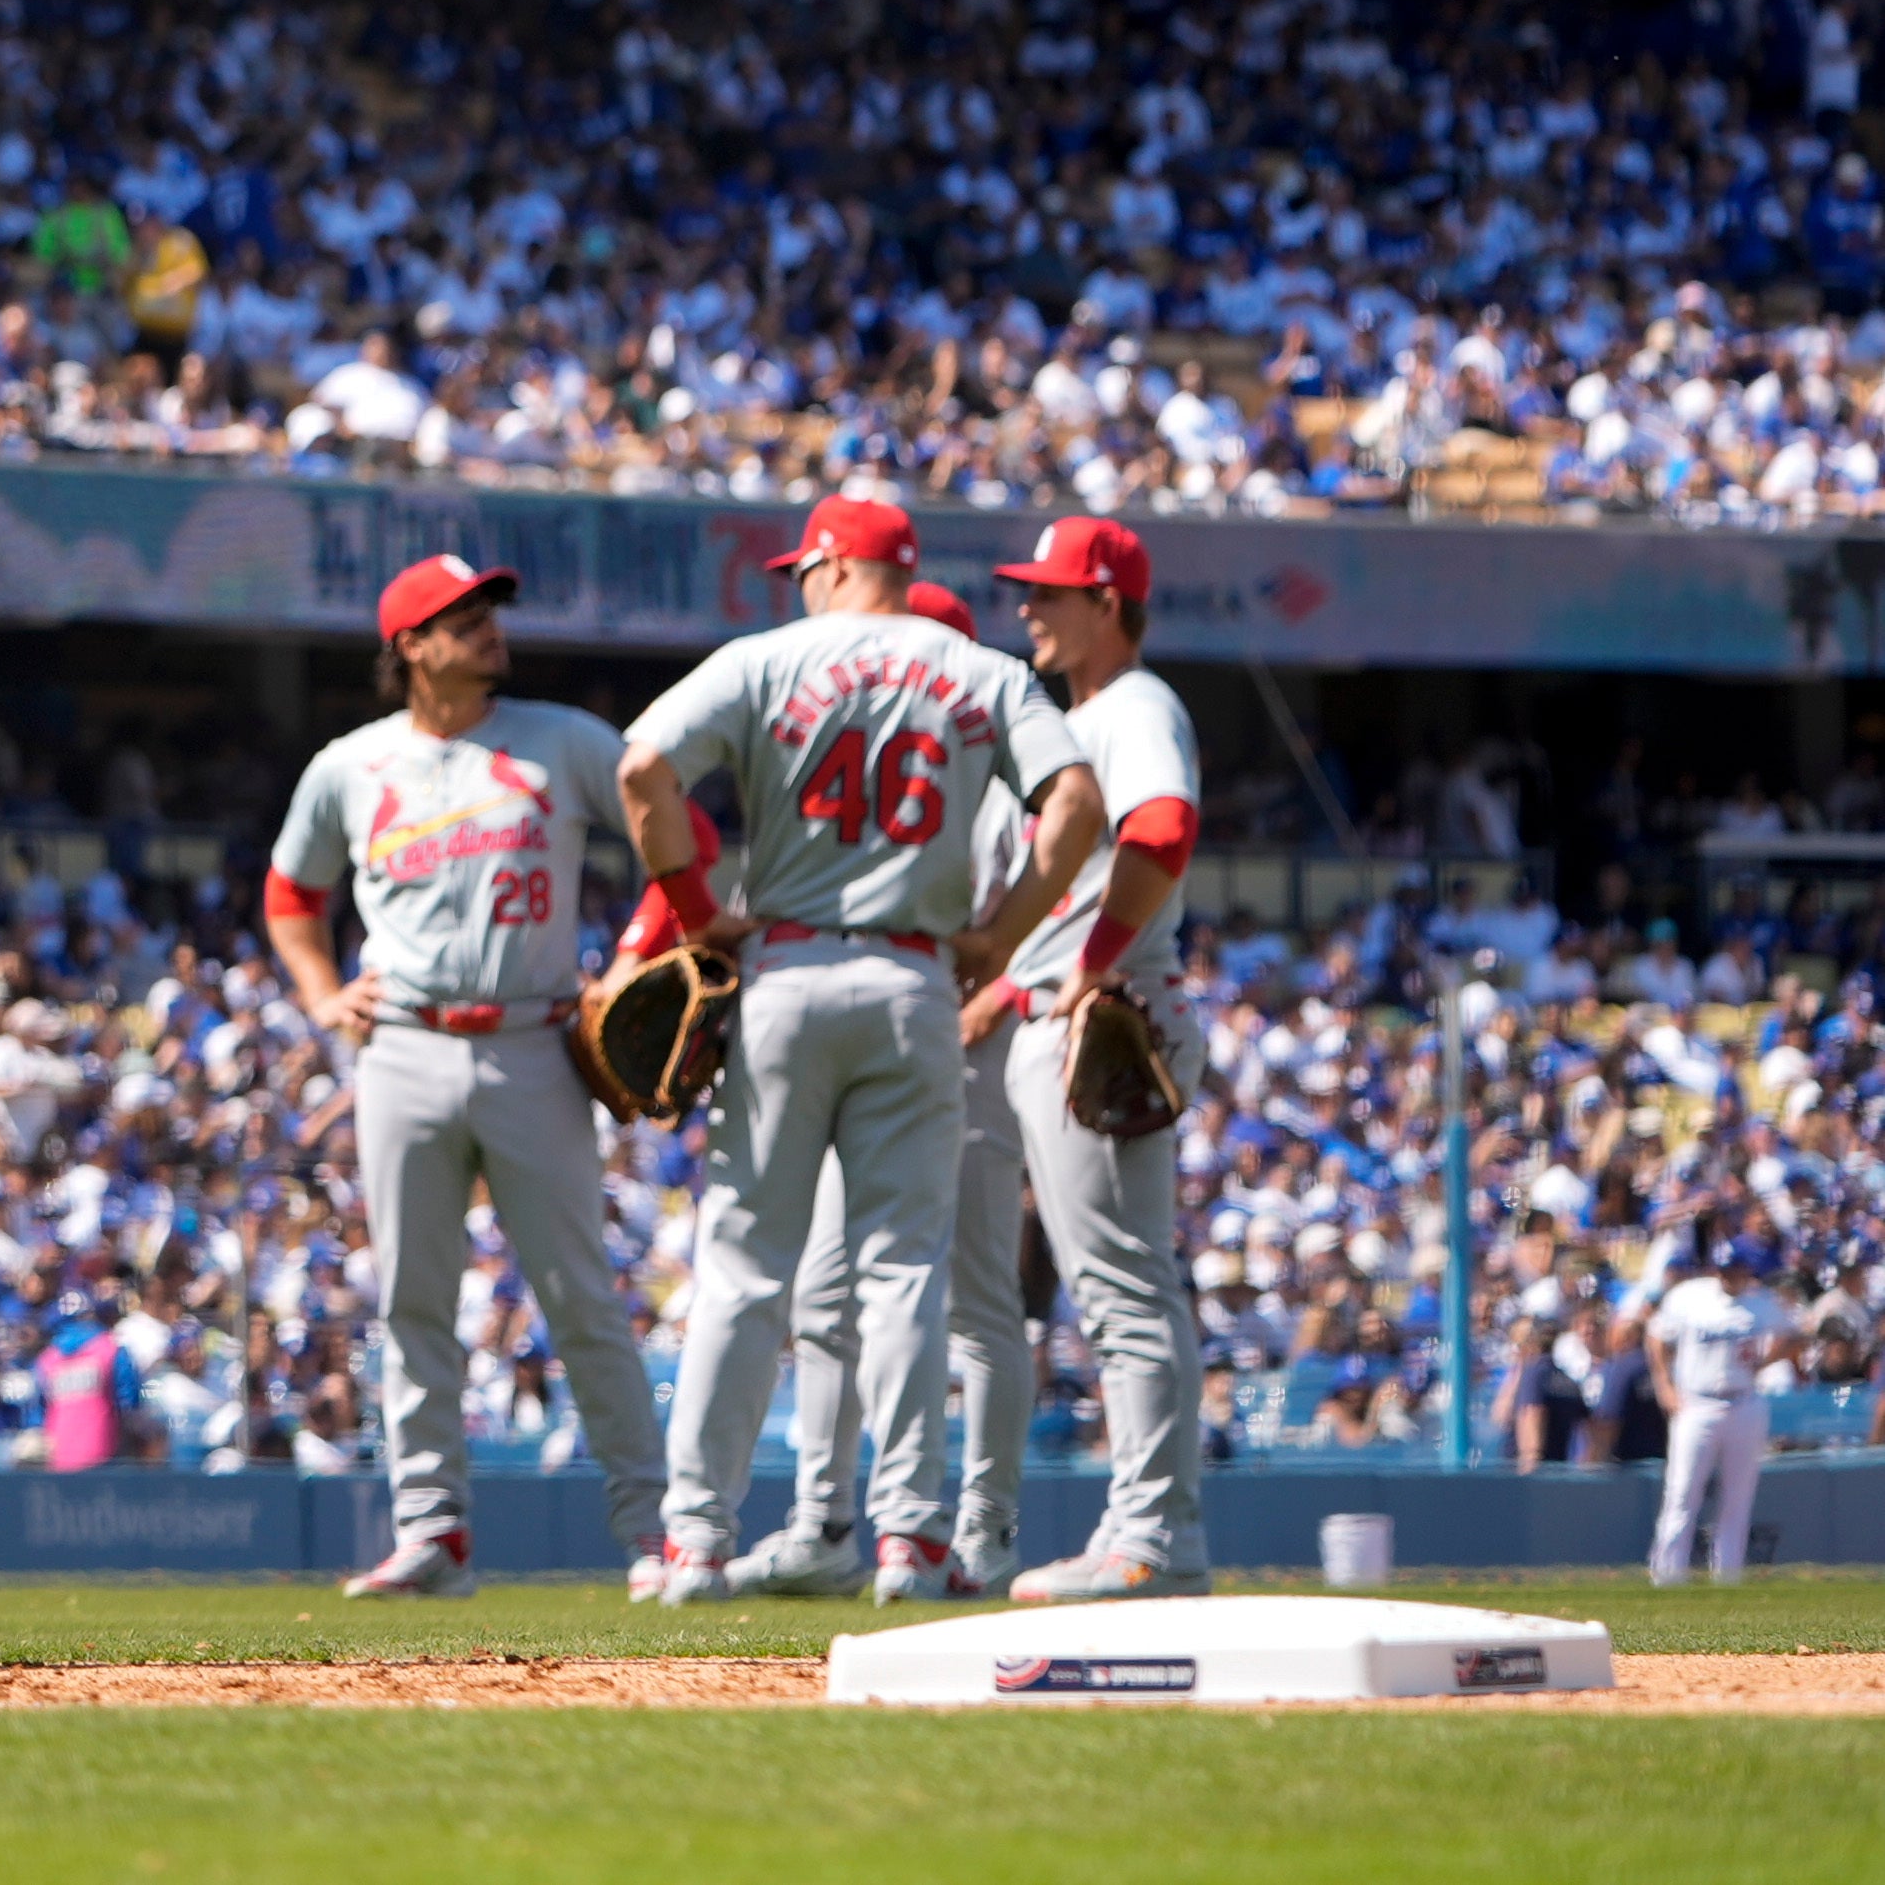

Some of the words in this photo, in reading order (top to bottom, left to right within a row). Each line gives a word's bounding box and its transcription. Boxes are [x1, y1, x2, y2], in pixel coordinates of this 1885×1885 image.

[799, 727, 949, 846] 46
[385, 817, 550, 883] Cardinals
[492, 868, 552, 925] 28
